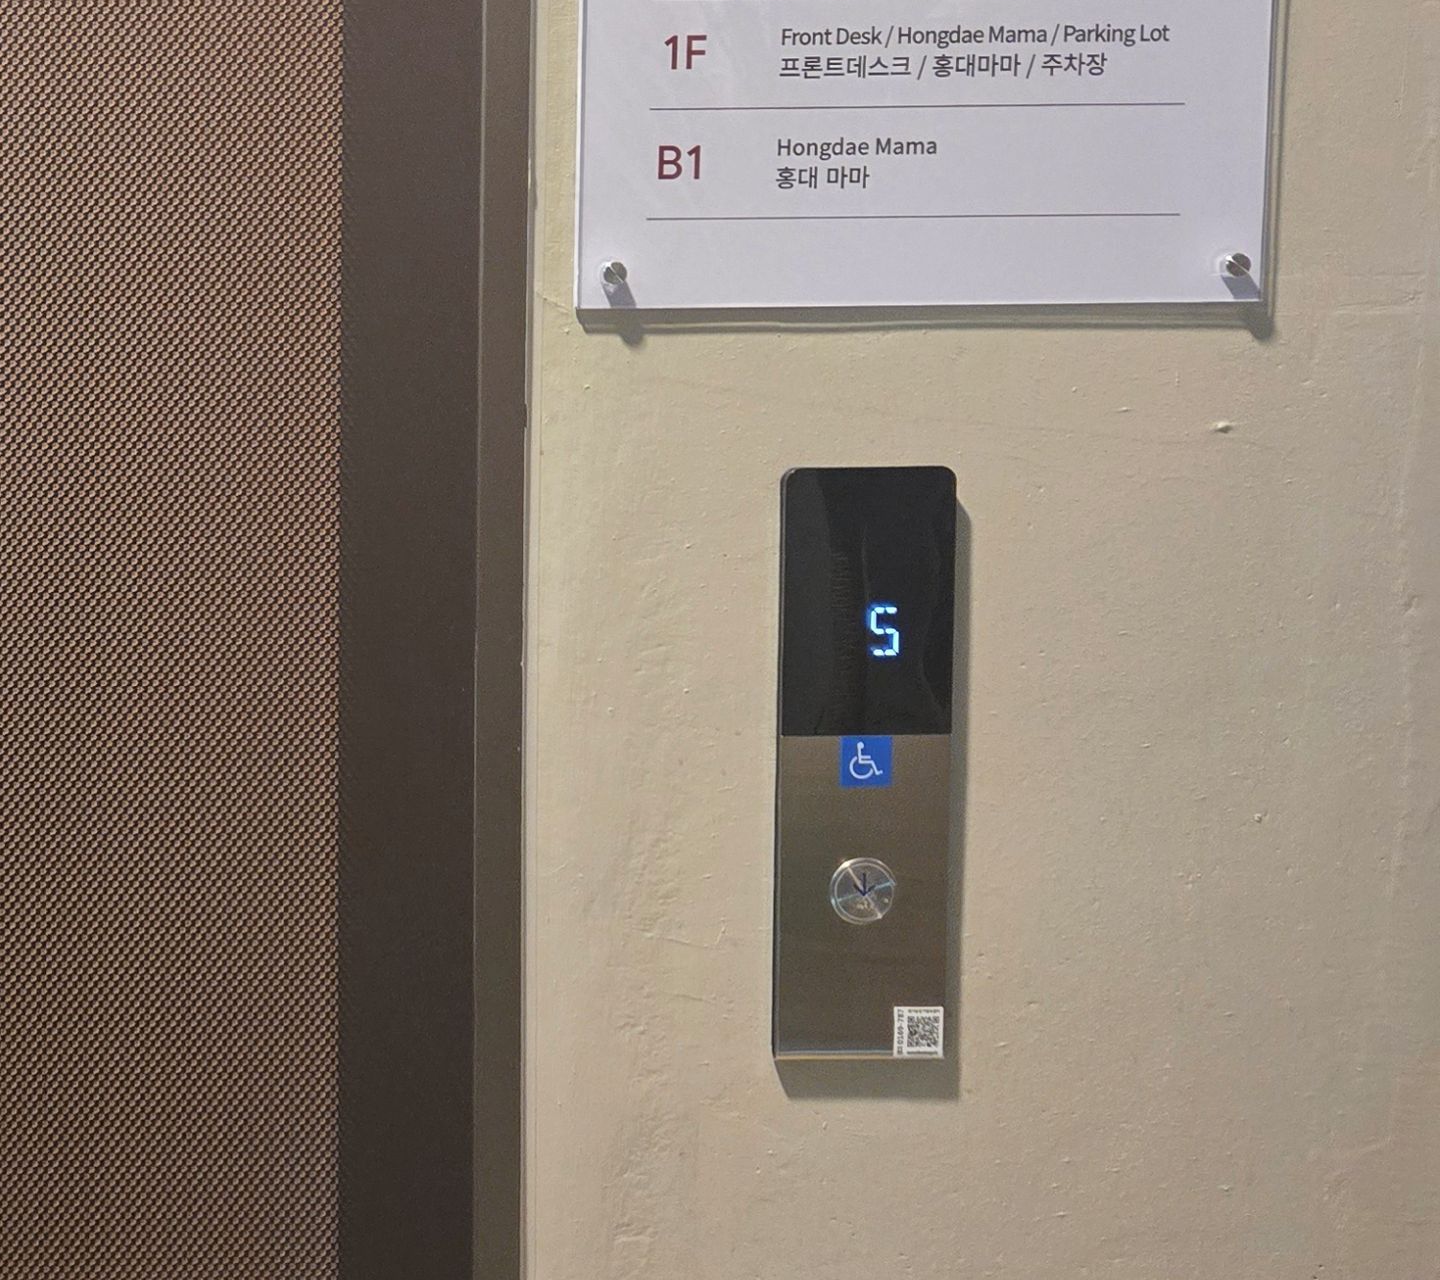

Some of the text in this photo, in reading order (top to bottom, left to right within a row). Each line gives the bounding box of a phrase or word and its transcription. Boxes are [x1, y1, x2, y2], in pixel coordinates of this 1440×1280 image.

[781, 28, 833, 46] Front
[835, 25, 883, 46] Desk
[897, 24, 985, 50] Hongdae
[988, 25, 1048, 44] Mama
[1063, 23, 1137, 48] Parking
[1139, 23, 1171, 43] Lot
[664, 34, 708, 71] 1F
[778, 54, 912, 80] 프론트데스크
[931, 52, 1022, 78] 홍대마마
[1040, 51, 1108, 77] 주차장
[657, 144, 702, 181] B1
[777, 136, 938, 161] Hongdae Mama
[775, 165, 871, 190] 홍대 마마
